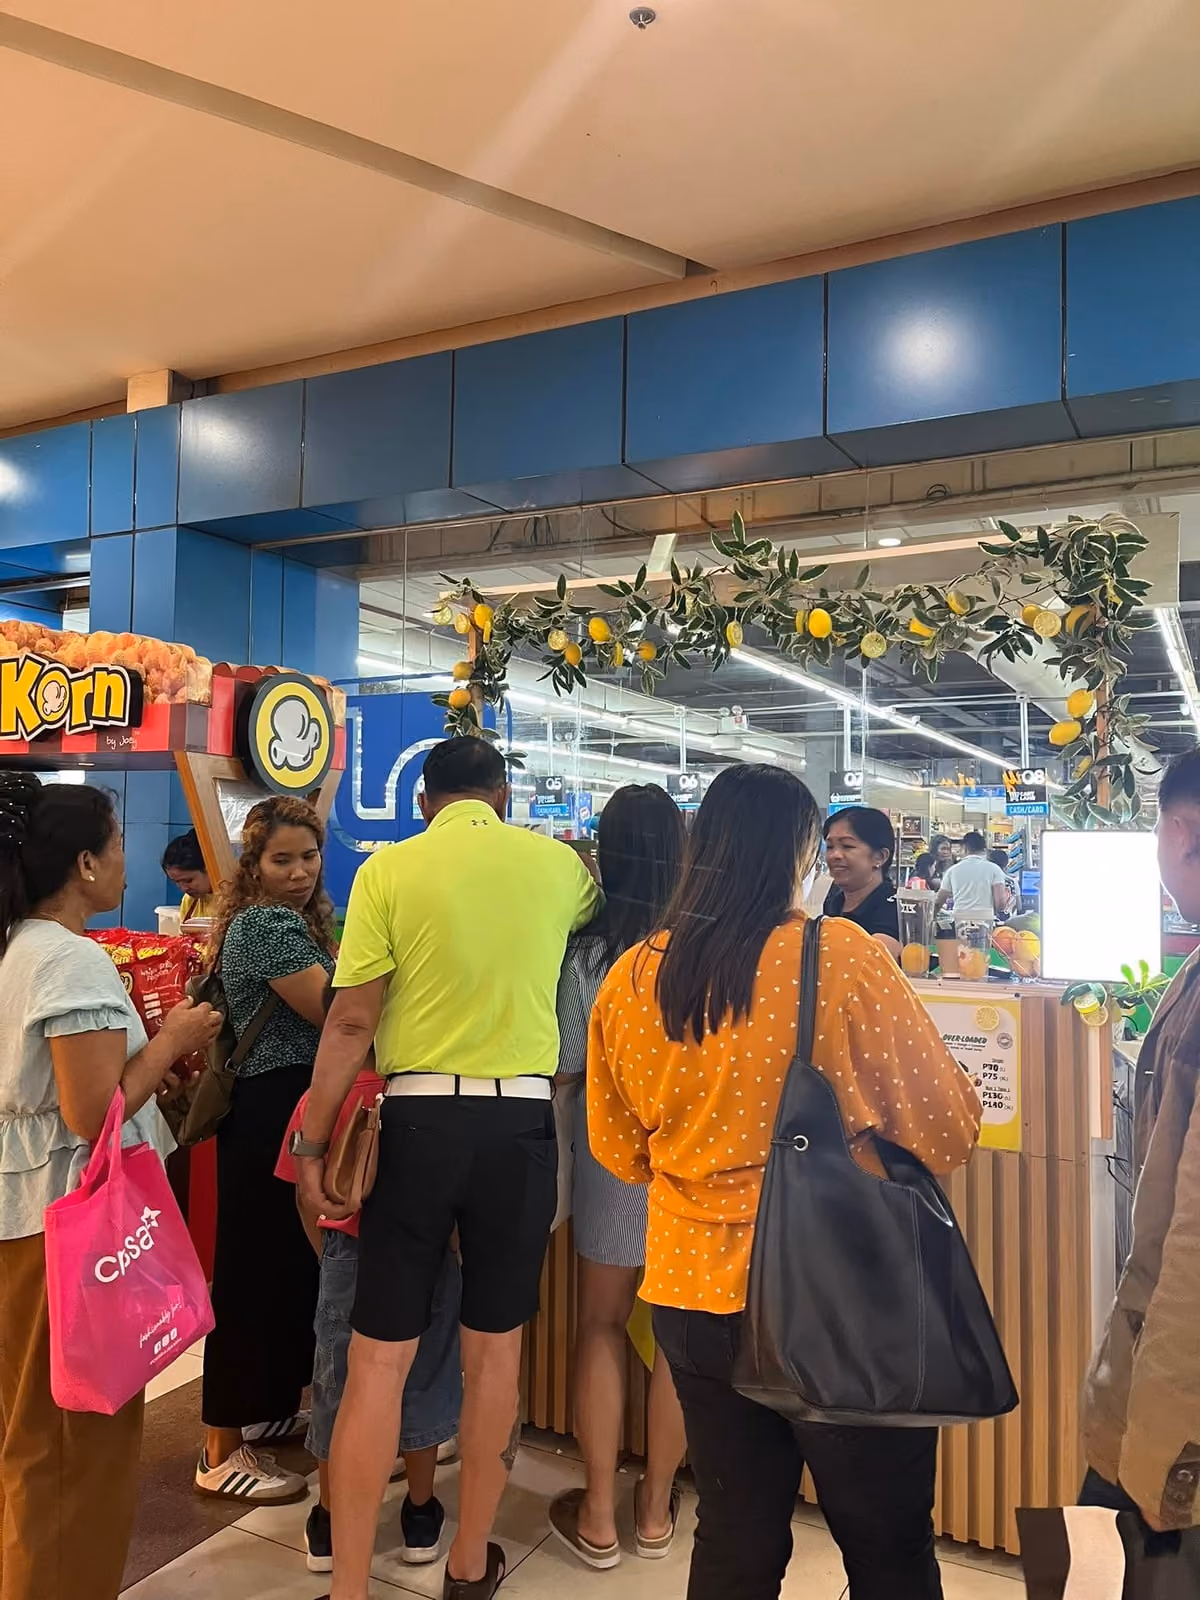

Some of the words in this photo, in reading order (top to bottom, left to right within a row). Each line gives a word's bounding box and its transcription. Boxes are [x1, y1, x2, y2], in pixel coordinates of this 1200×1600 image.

[0, 656, 129, 737] Korn
[106, 736, 116, 749] by
[546, 777, 562, 790] 05
[679, 774, 698, 789] 06
[844, 772, 863, 787] 07
[1022, 769, 1045, 785] 08
[1009, 806, 1044, 814] CASH/CARD
[982, 1072, 998, 1080] P75
